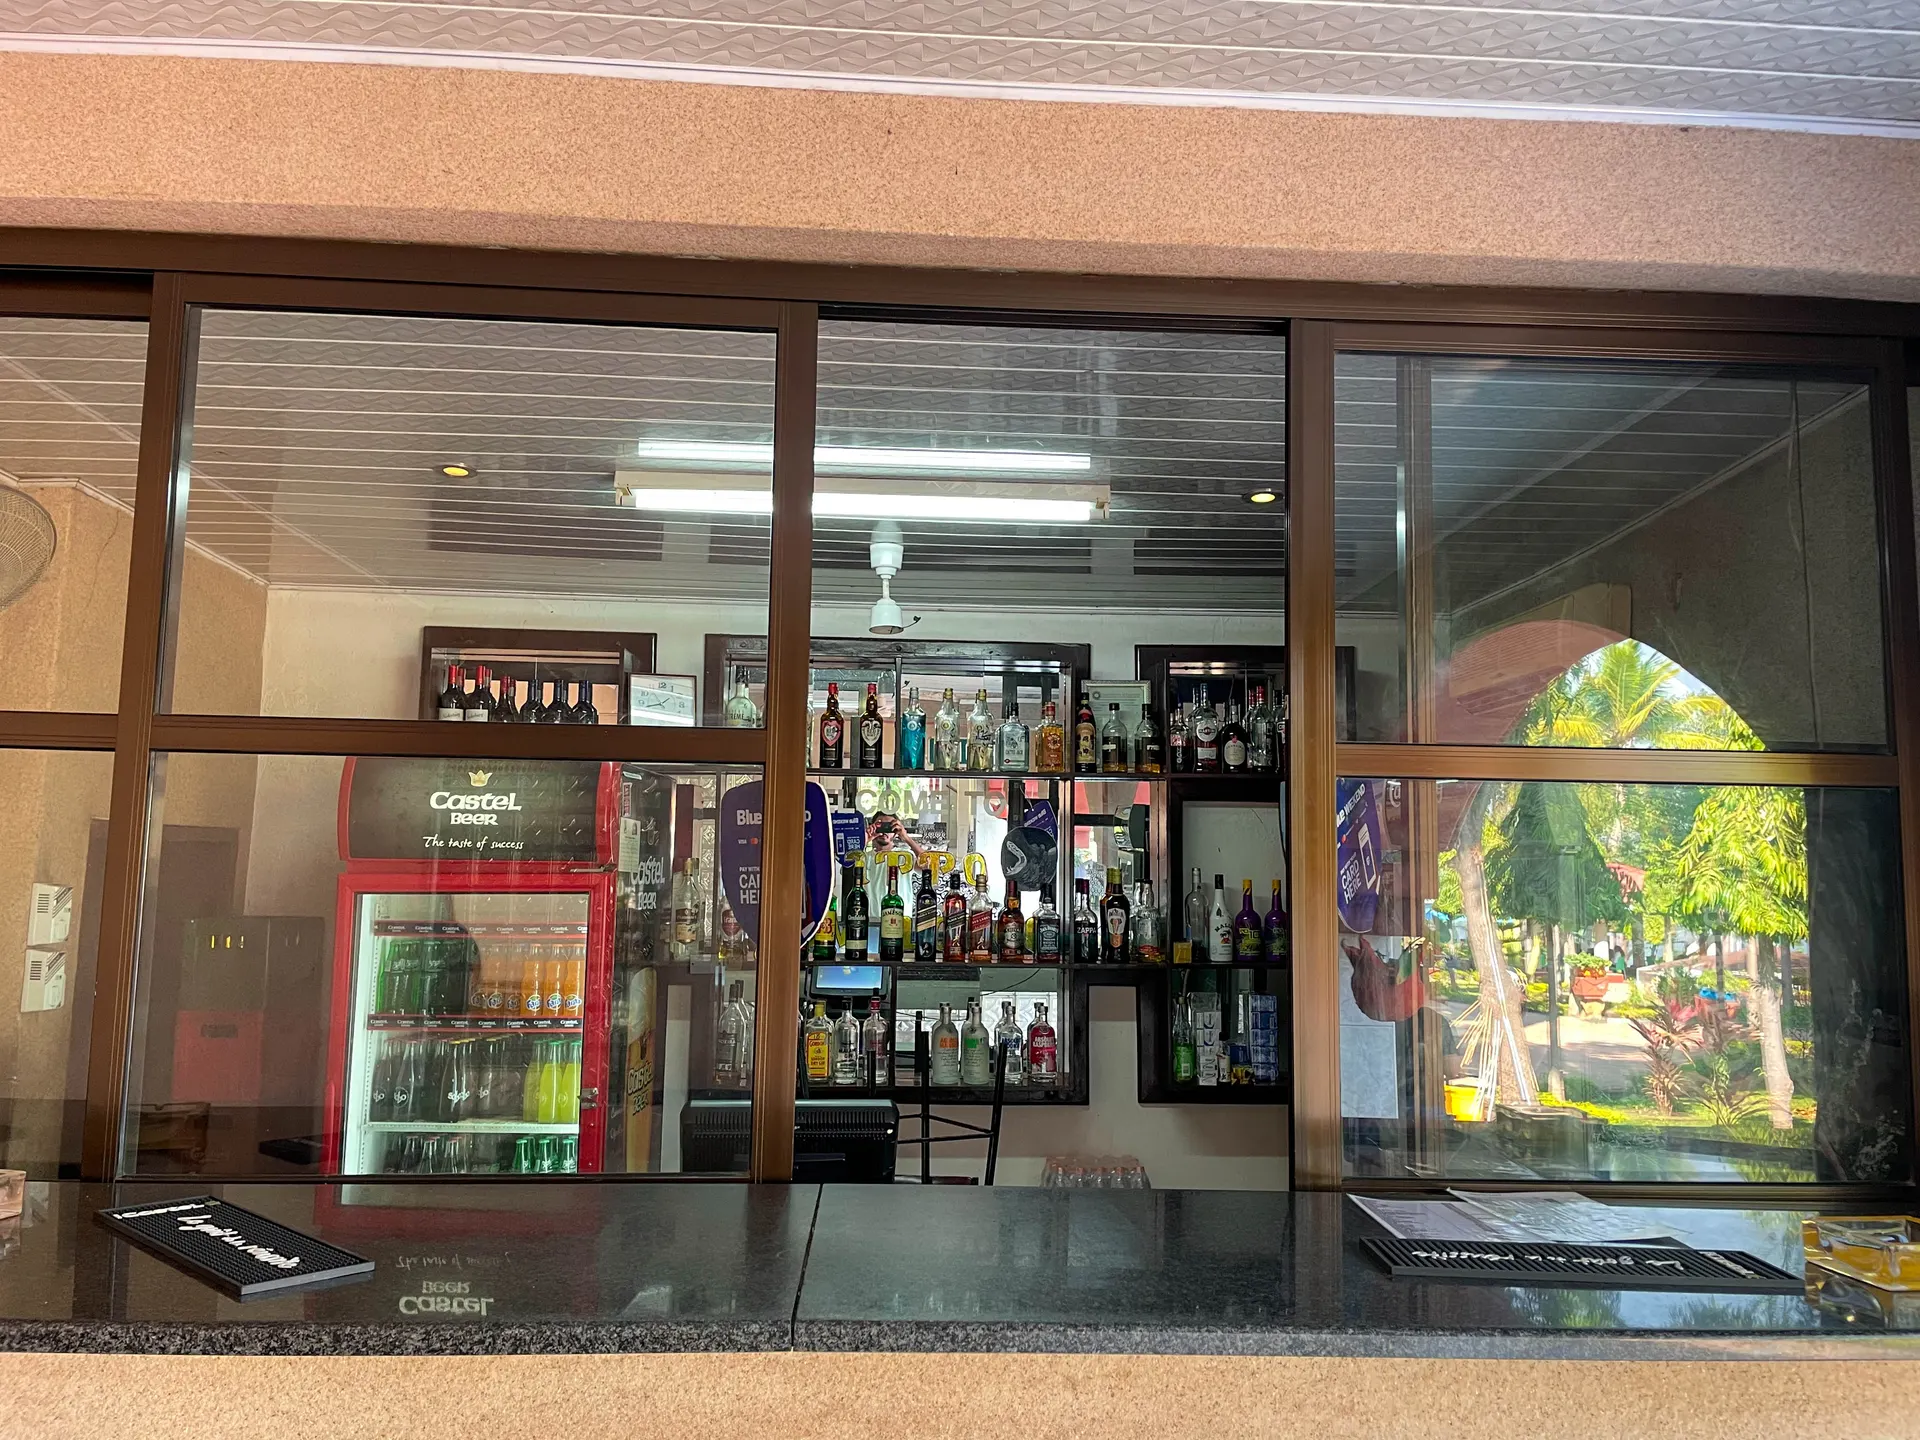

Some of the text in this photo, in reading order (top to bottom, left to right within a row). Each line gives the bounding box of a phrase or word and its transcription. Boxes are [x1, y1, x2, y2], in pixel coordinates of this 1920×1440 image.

[964, 790, 1007, 816] TO
[449, 812, 499, 826] BEER
[422, 834, 524, 851] The taste of success
[1341, 859, 1360, 889] CARD
[1344, 873, 1362, 904] HERE
